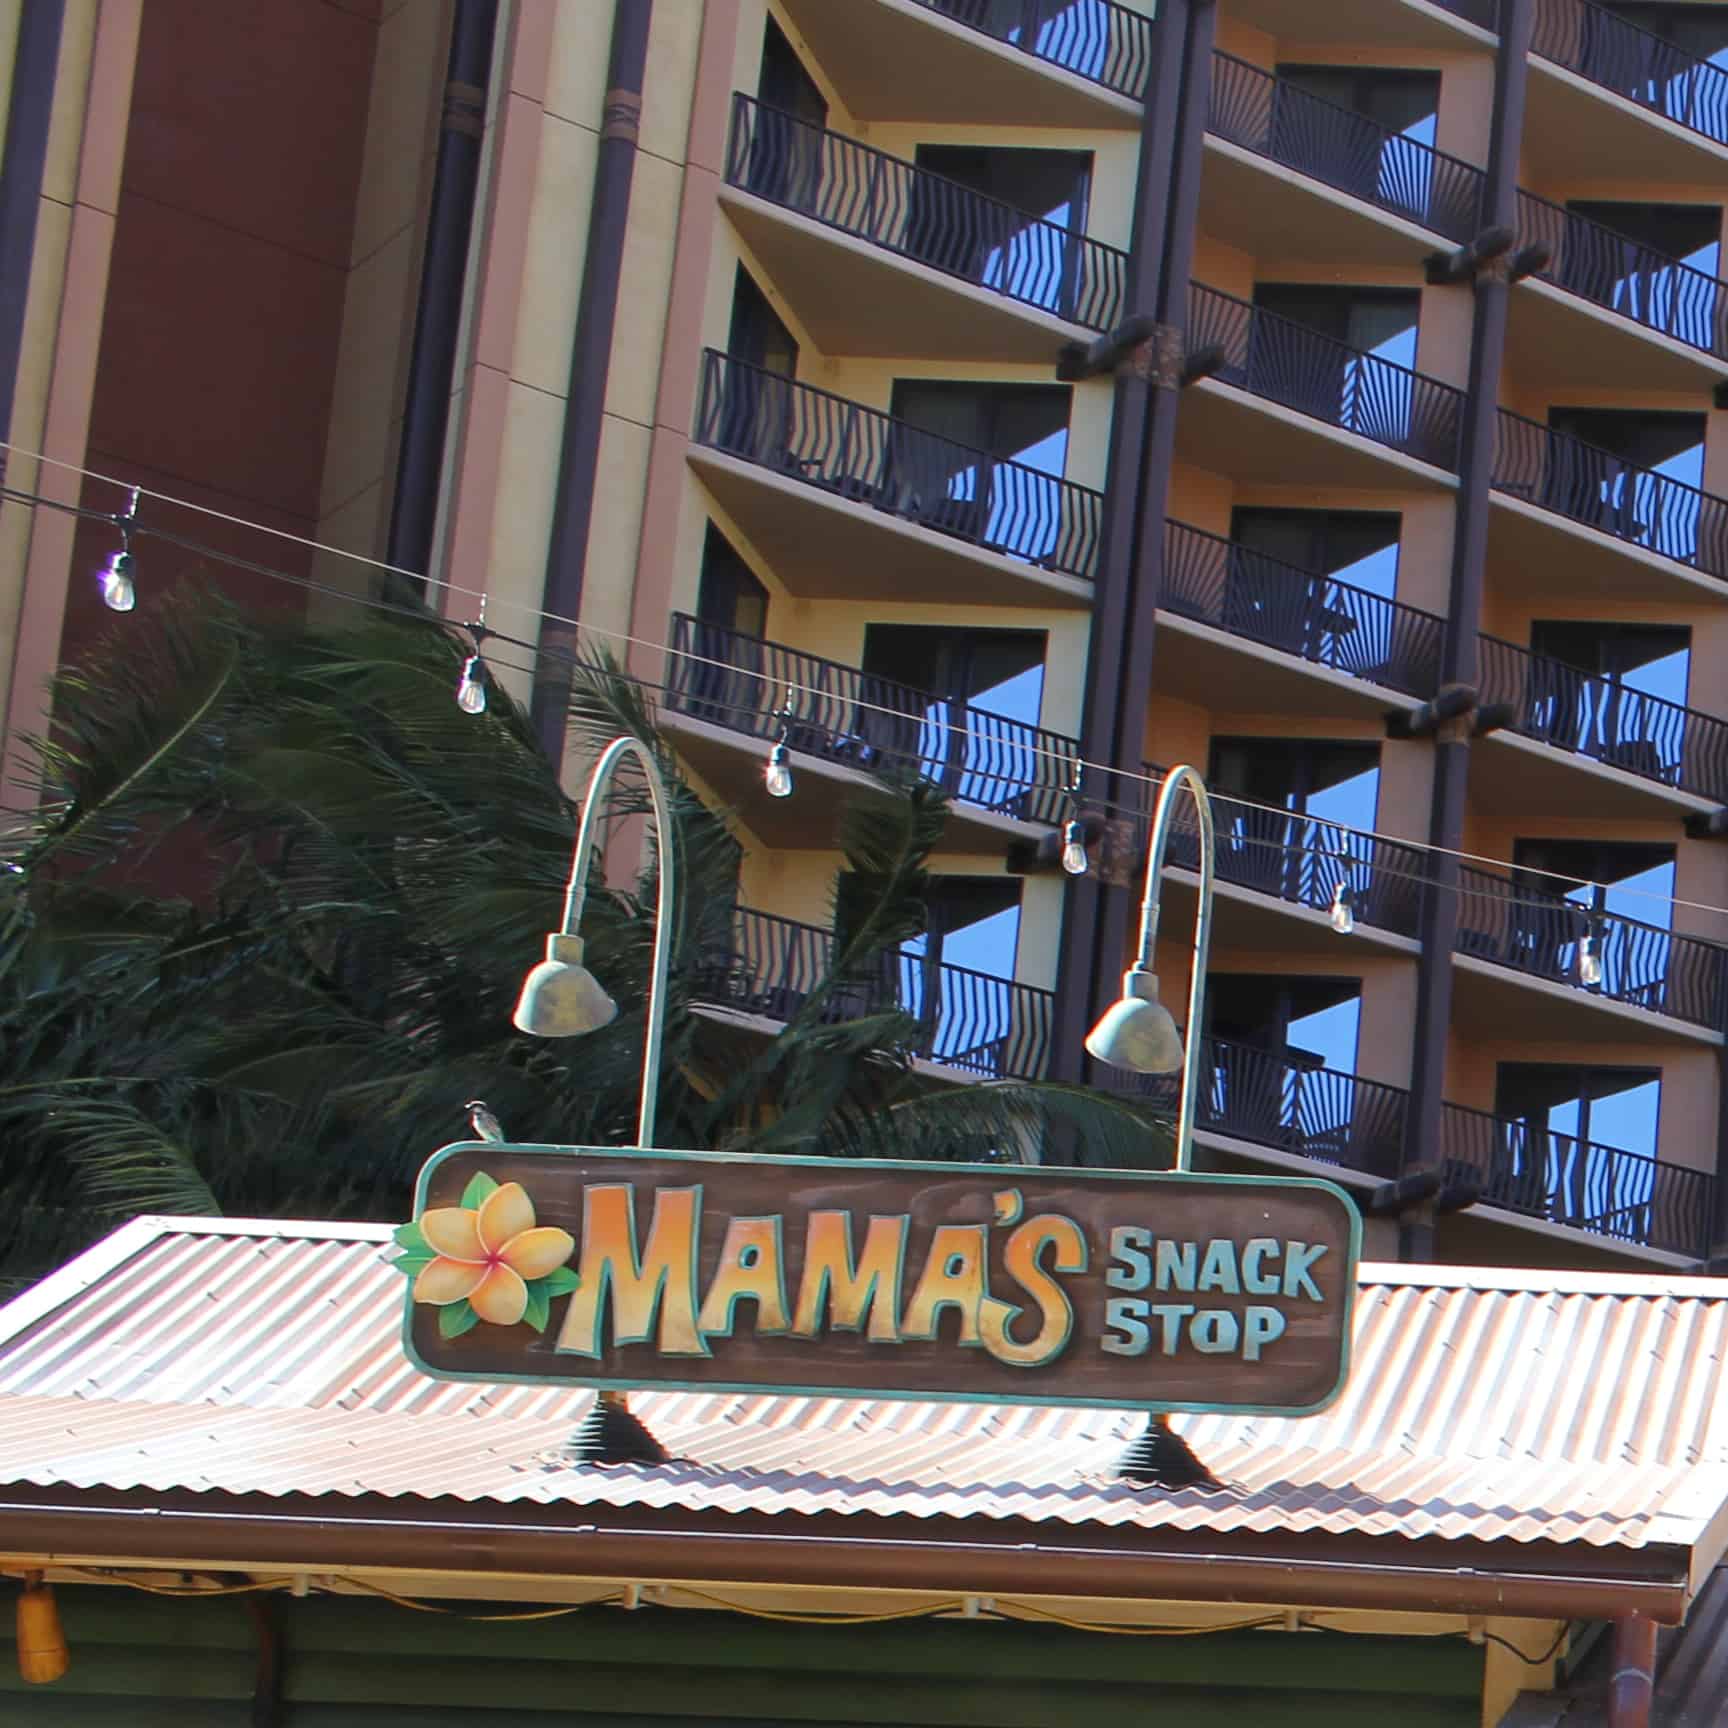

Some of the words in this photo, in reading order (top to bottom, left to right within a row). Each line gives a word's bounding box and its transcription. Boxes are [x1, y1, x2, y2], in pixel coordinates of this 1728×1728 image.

[553, 1182, 1086, 1368] MAMA'S
[1106, 1224, 1329, 1302] SNACK
[1100, 1297, 1287, 1361] STOP
